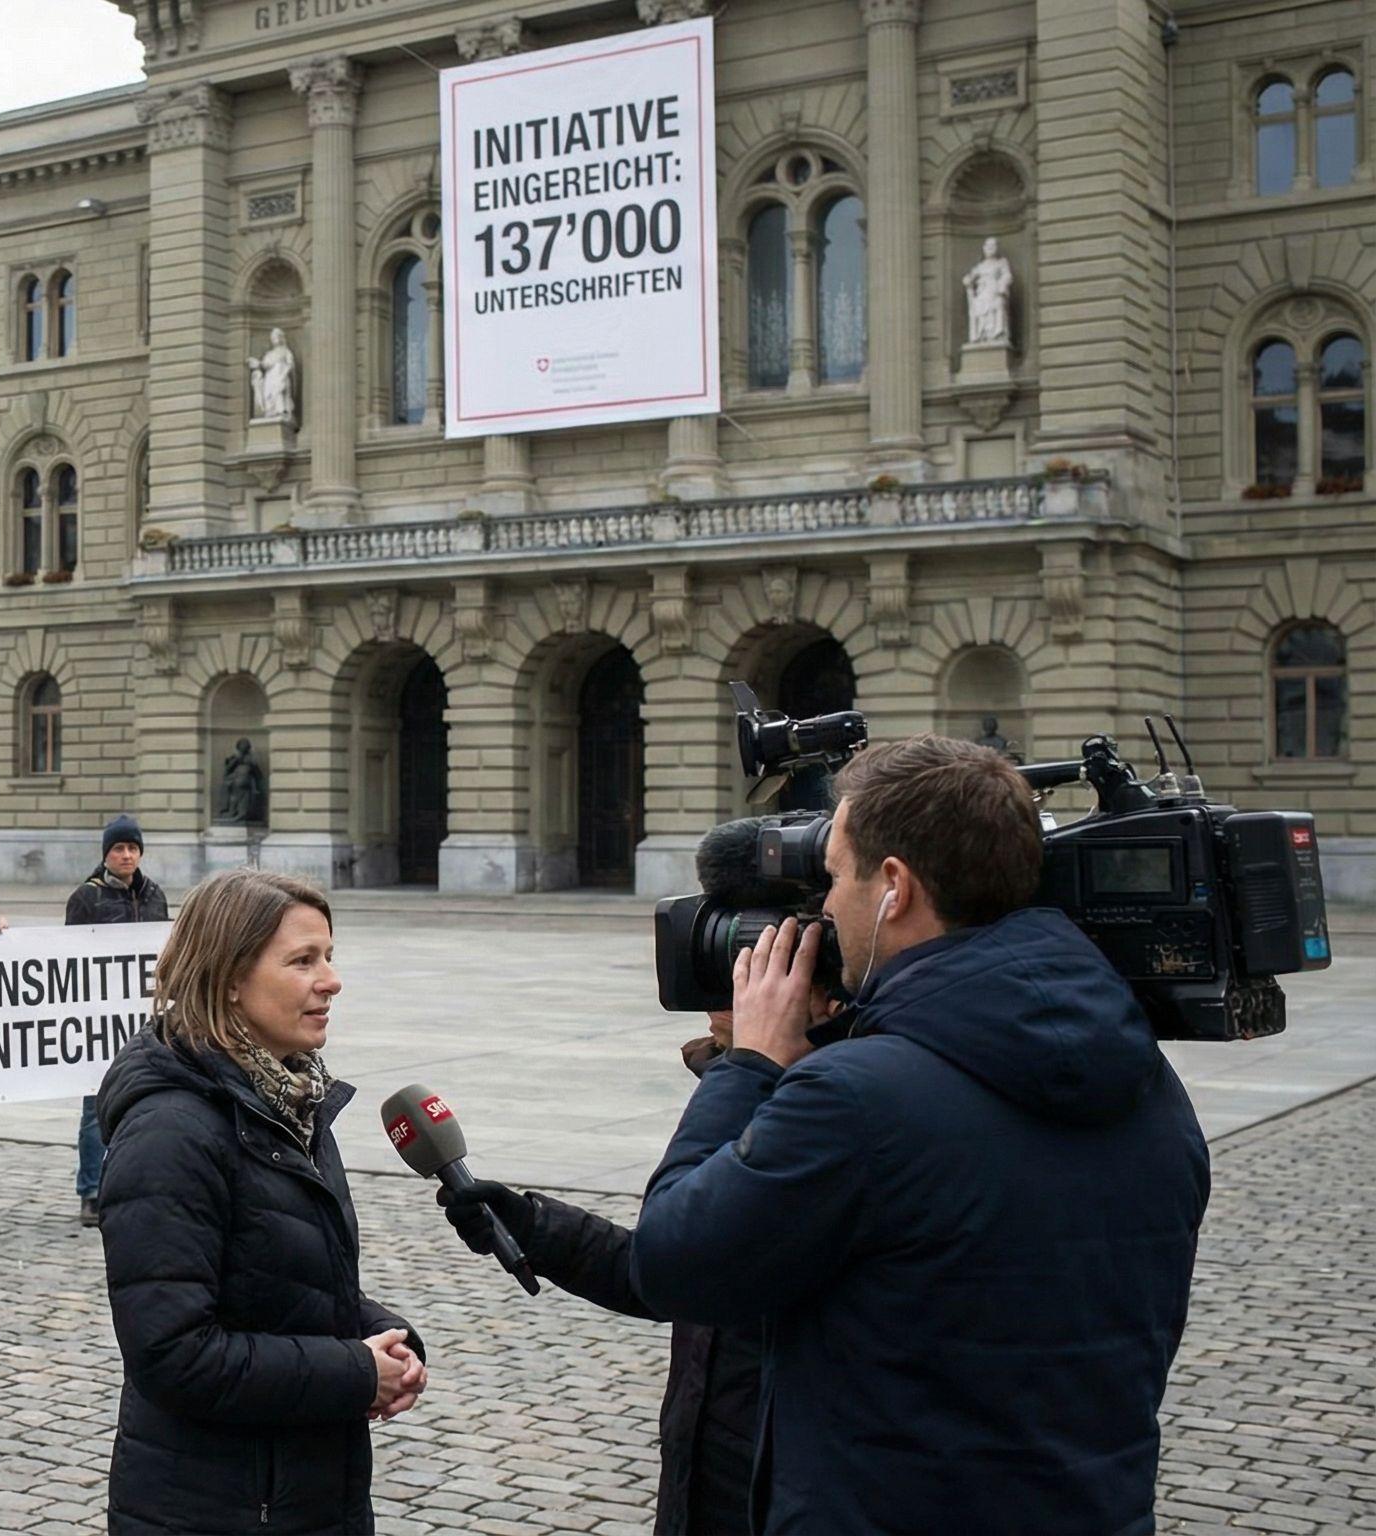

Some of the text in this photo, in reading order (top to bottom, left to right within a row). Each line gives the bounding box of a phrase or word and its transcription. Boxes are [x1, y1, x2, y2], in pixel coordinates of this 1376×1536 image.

[474, 95, 680, 169] INITIATIVE
[474, 151, 682, 212] EINGEREICHT:
[474, 198, 681, 278] 137'000
[475, 265, 682, 315] UNTERSCHRIFTEN
